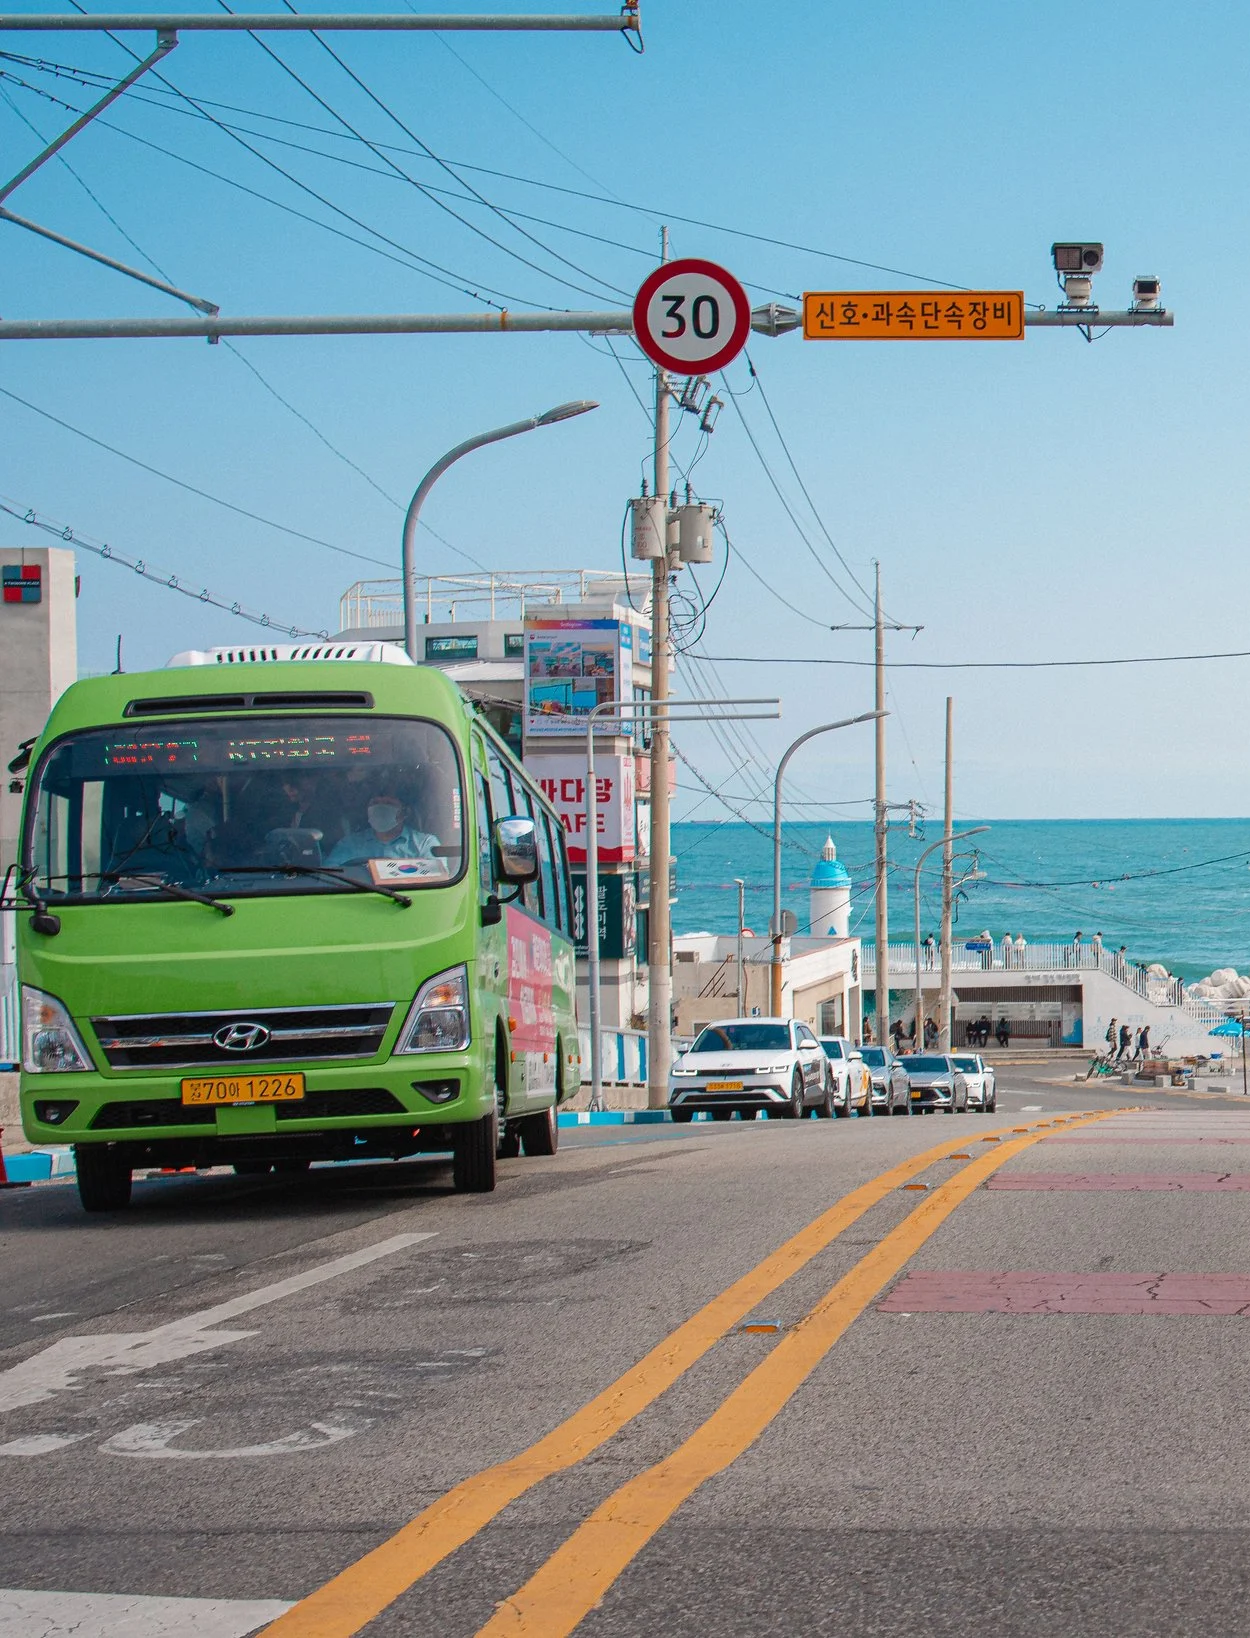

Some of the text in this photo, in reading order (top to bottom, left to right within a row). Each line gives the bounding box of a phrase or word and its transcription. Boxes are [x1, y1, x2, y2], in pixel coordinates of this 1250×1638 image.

[660, 295, 719, 339] 30
[815, 301, 1012, 332] 신호·과속단속장비
[560, 813, 605, 833] AFE
[246, 1078, 296, 1099] 1226
